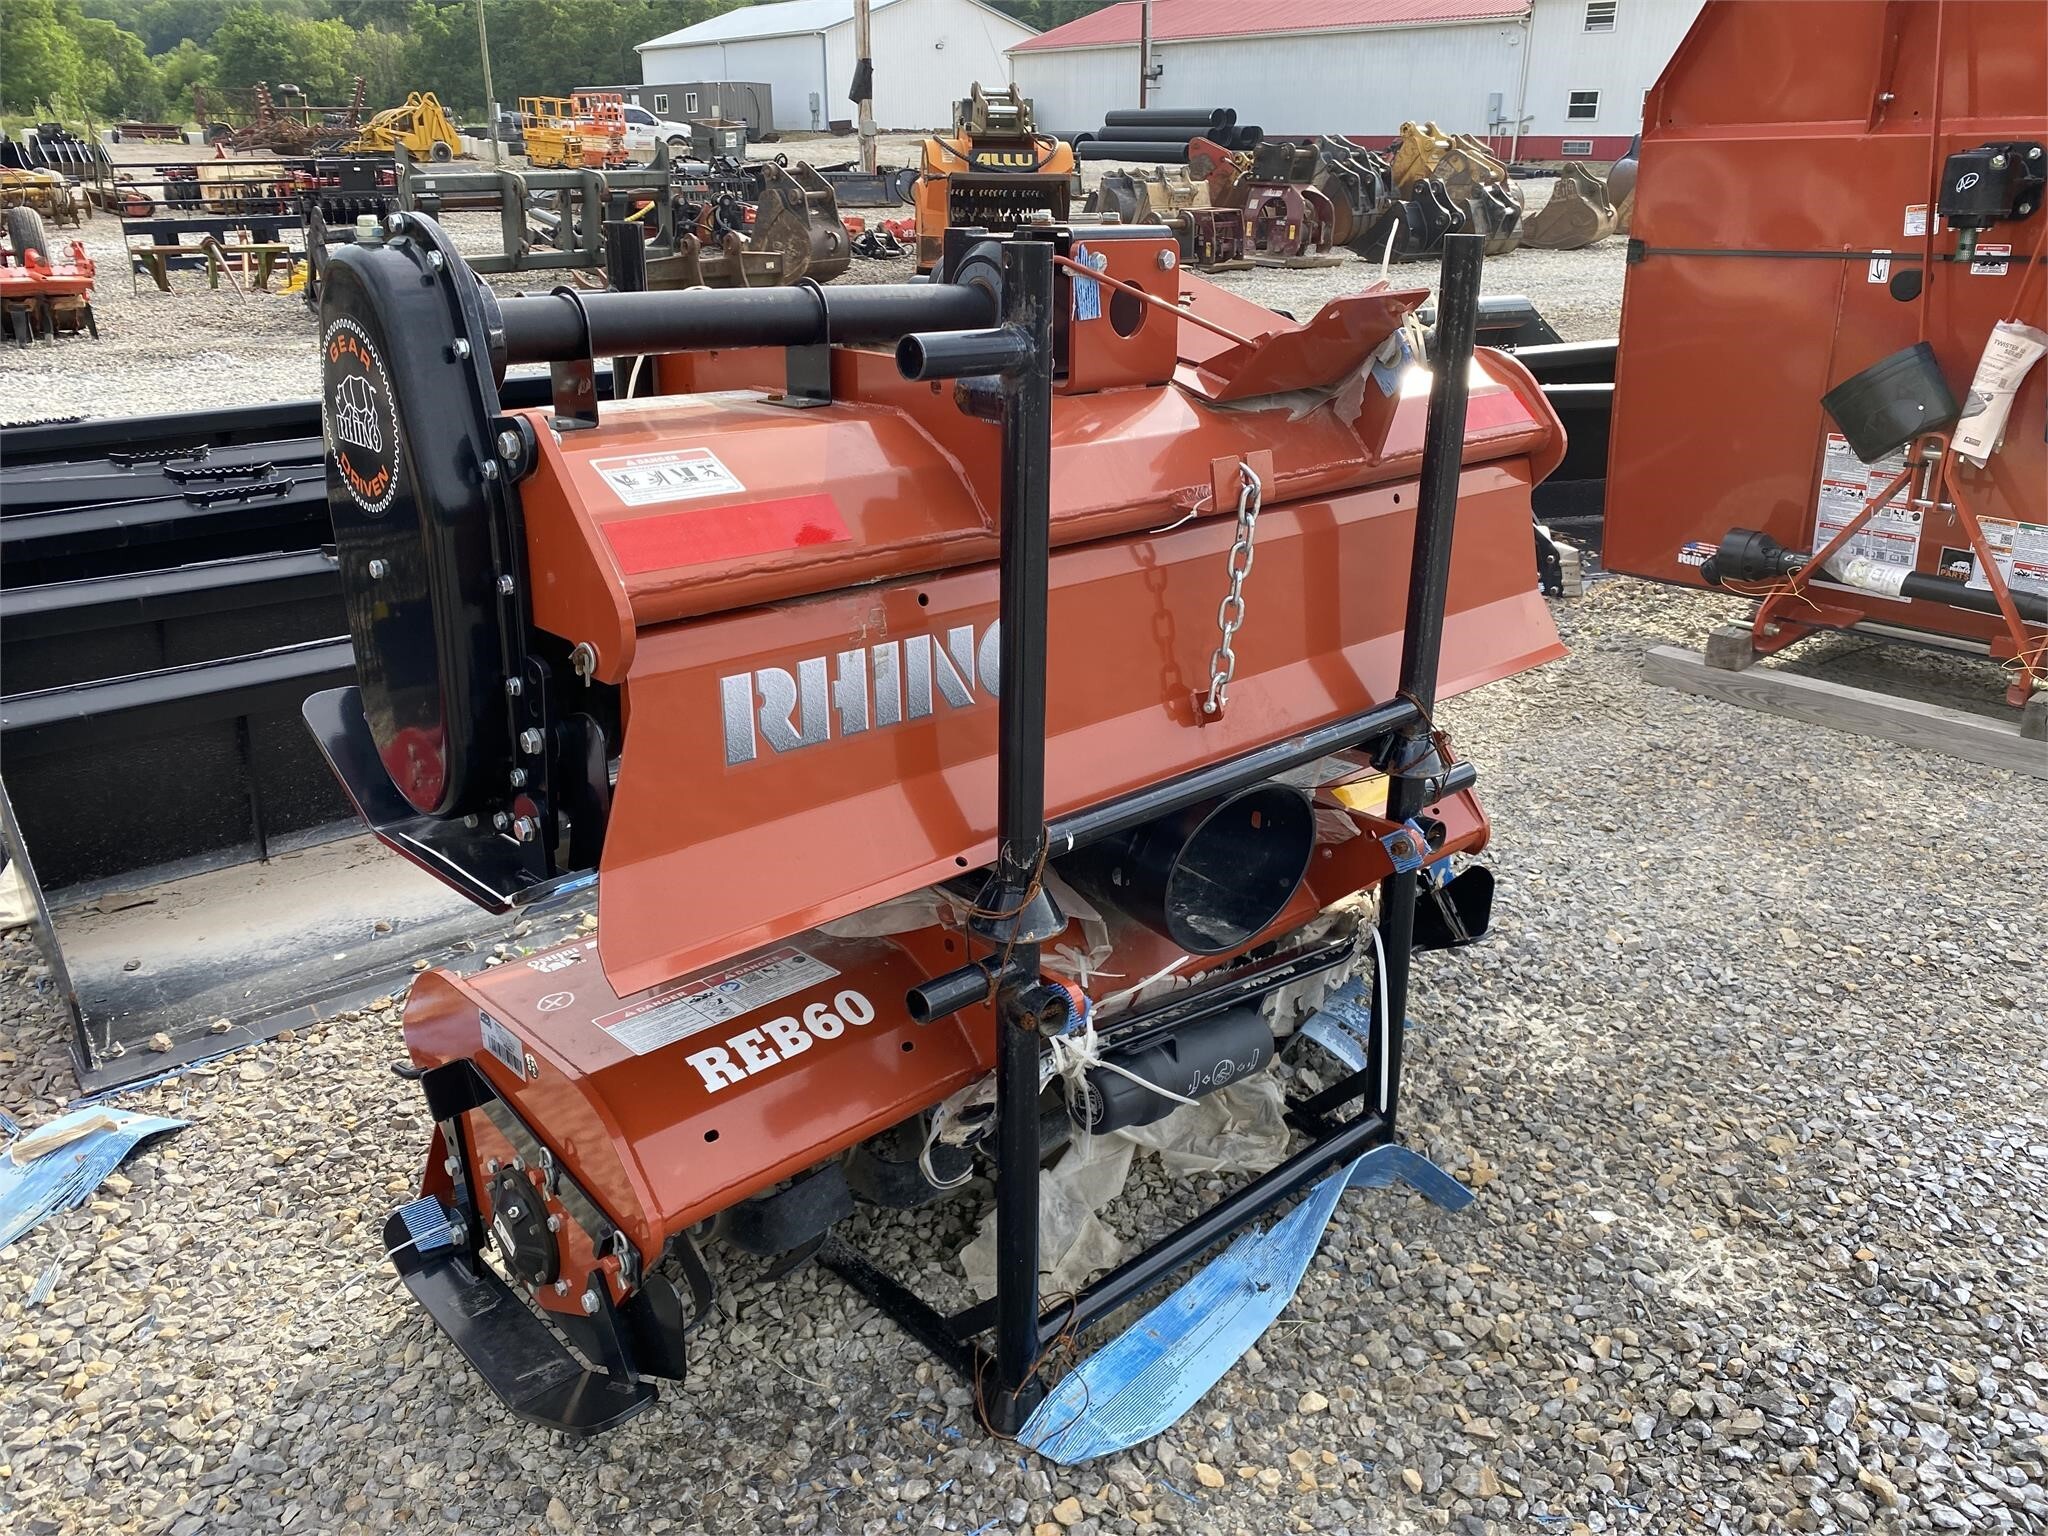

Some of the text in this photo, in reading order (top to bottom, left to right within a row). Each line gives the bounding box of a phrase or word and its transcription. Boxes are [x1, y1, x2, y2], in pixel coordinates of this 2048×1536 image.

[976, 153, 1032, 166] ALLU
[329, 334, 372, 373] GEAR
[340, 452, 390, 498] DRIVEN
[1940, 568, 1969, 581] PARTS
[735, 955, 781, 977] DANGER
[636, 990, 689, 1013] DANGER
[685, 990, 875, 1094] REB60
